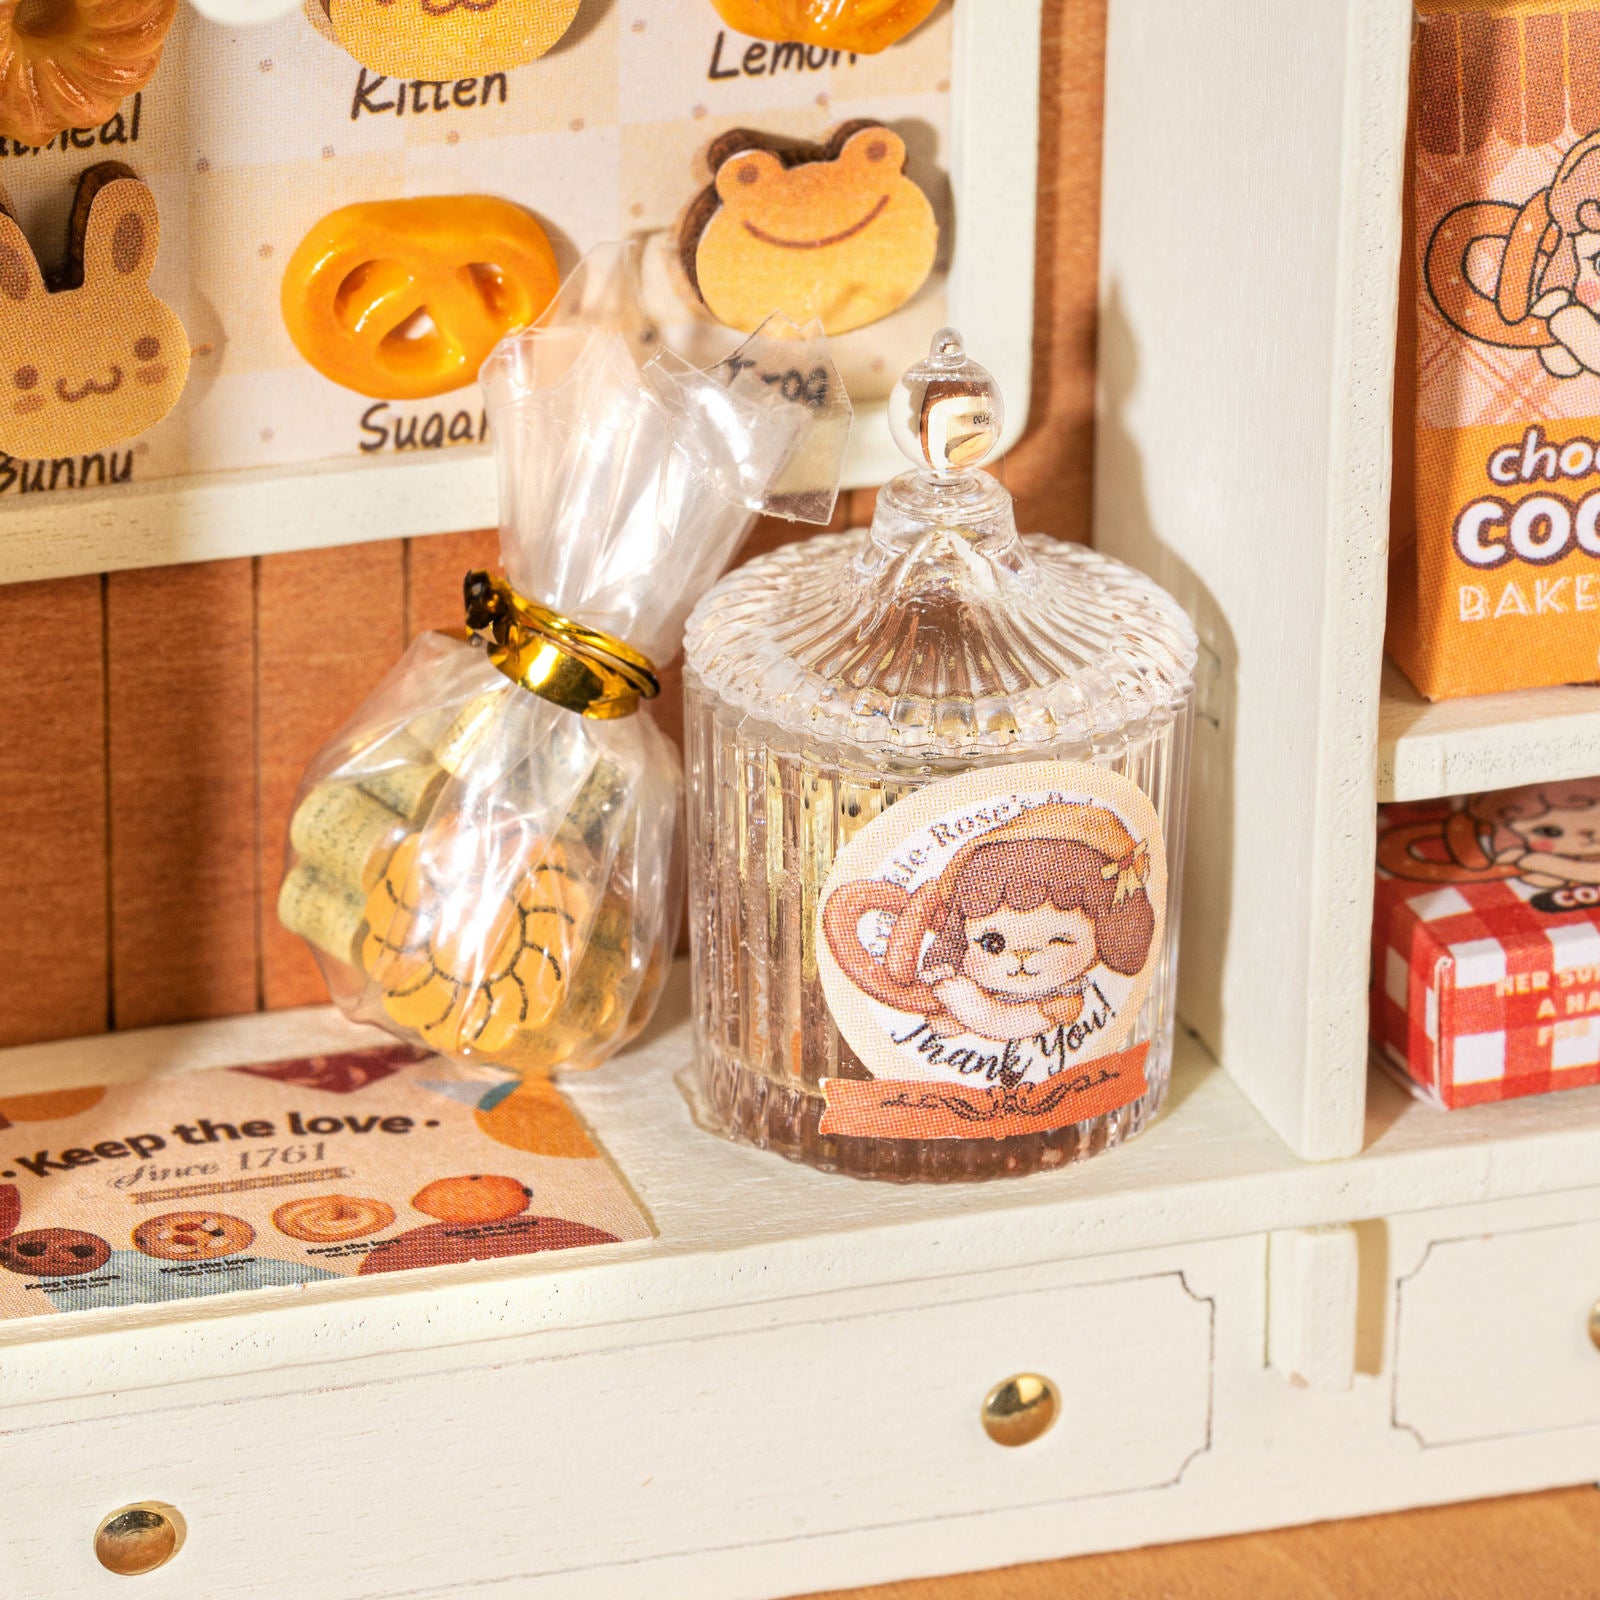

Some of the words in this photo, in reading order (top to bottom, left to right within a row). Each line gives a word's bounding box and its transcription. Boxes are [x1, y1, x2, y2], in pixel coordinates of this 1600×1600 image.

[350, 67, 507, 120] Kitten
[0, 91, 142, 156] eal
[1488, 426, 1600, 485] cho
[1552, 886, 1600, 907] CO
[1496, 970, 1550, 998] HER
[1559, 962, 1600, 989] SU
[890, 1022, 1033, 1085] Thank
[1032, 980, 1117, 1077] You!
[1536, 998, 1557, 1019] A
[15, 1132, 167, 1178] Keep
[172, 1118, 275, 1146] the
[287, 1111, 416, 1136] love
[107, 1161, 220, 1189] Since
[238, 1142, 326, 1171] 1761
